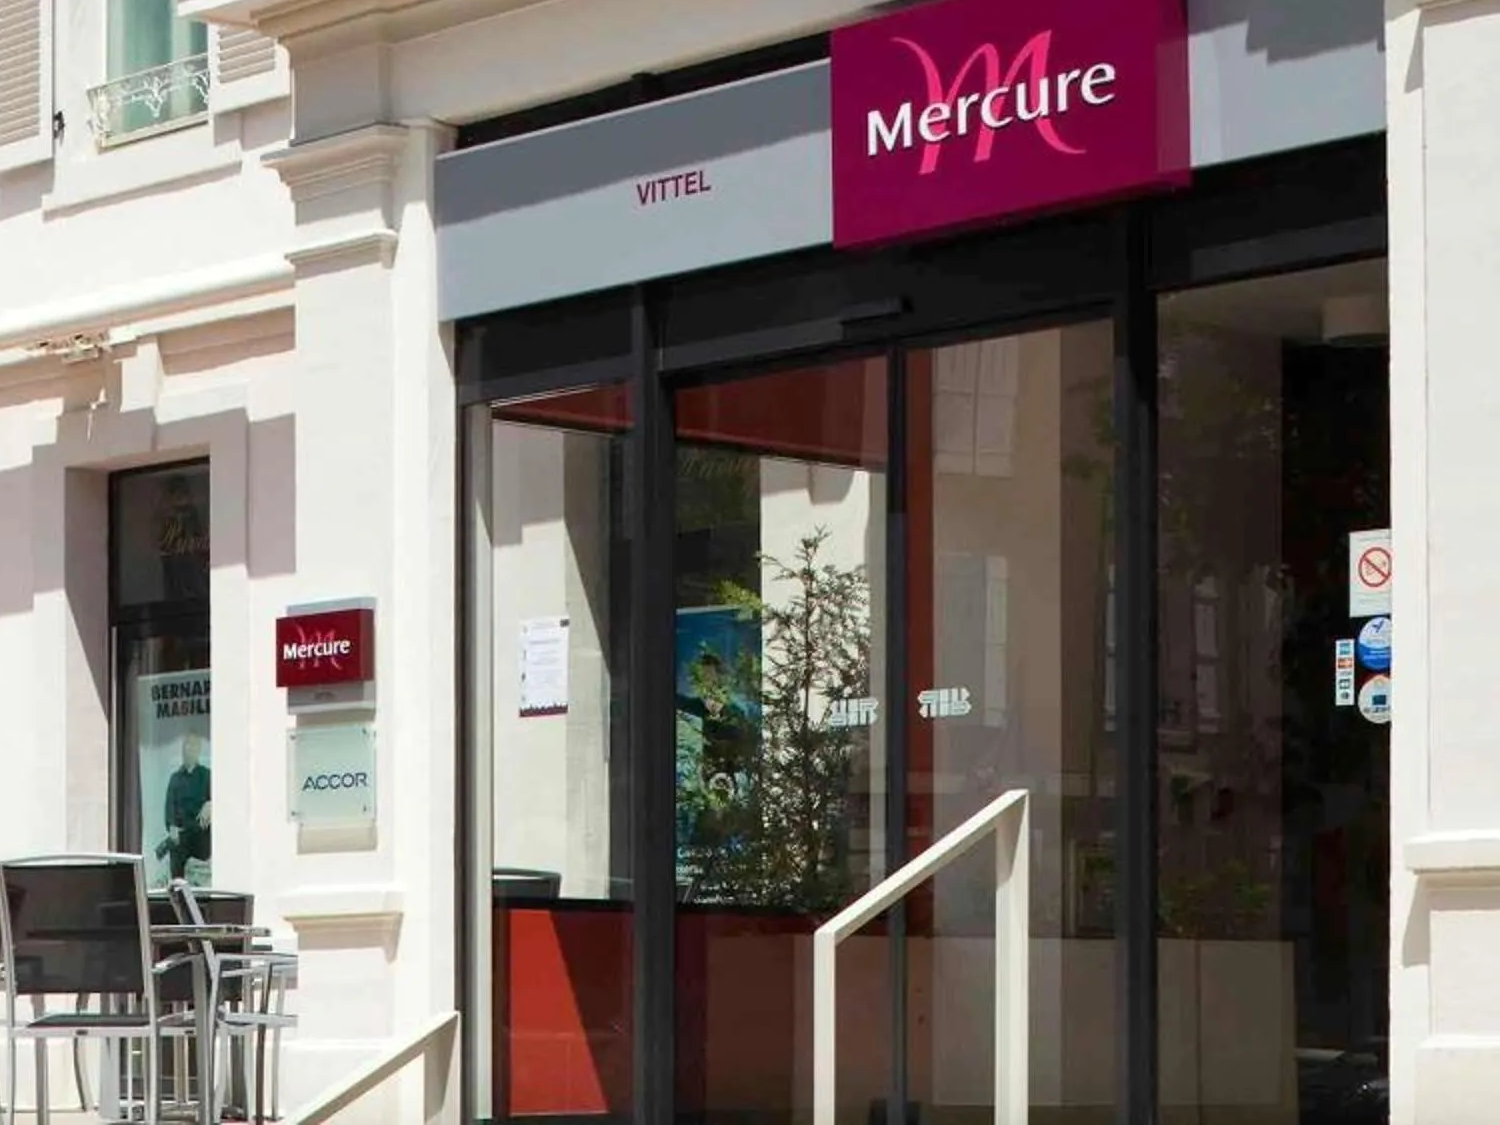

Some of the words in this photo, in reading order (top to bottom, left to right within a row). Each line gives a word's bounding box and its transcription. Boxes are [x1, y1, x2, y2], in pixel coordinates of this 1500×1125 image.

[866, 61, 1117, 157] Mercure
[636, 170, 712, 206] VITTEL
[282, 638, 351, 661] Mercure
[301, 771, 368, 792] ACCOR
